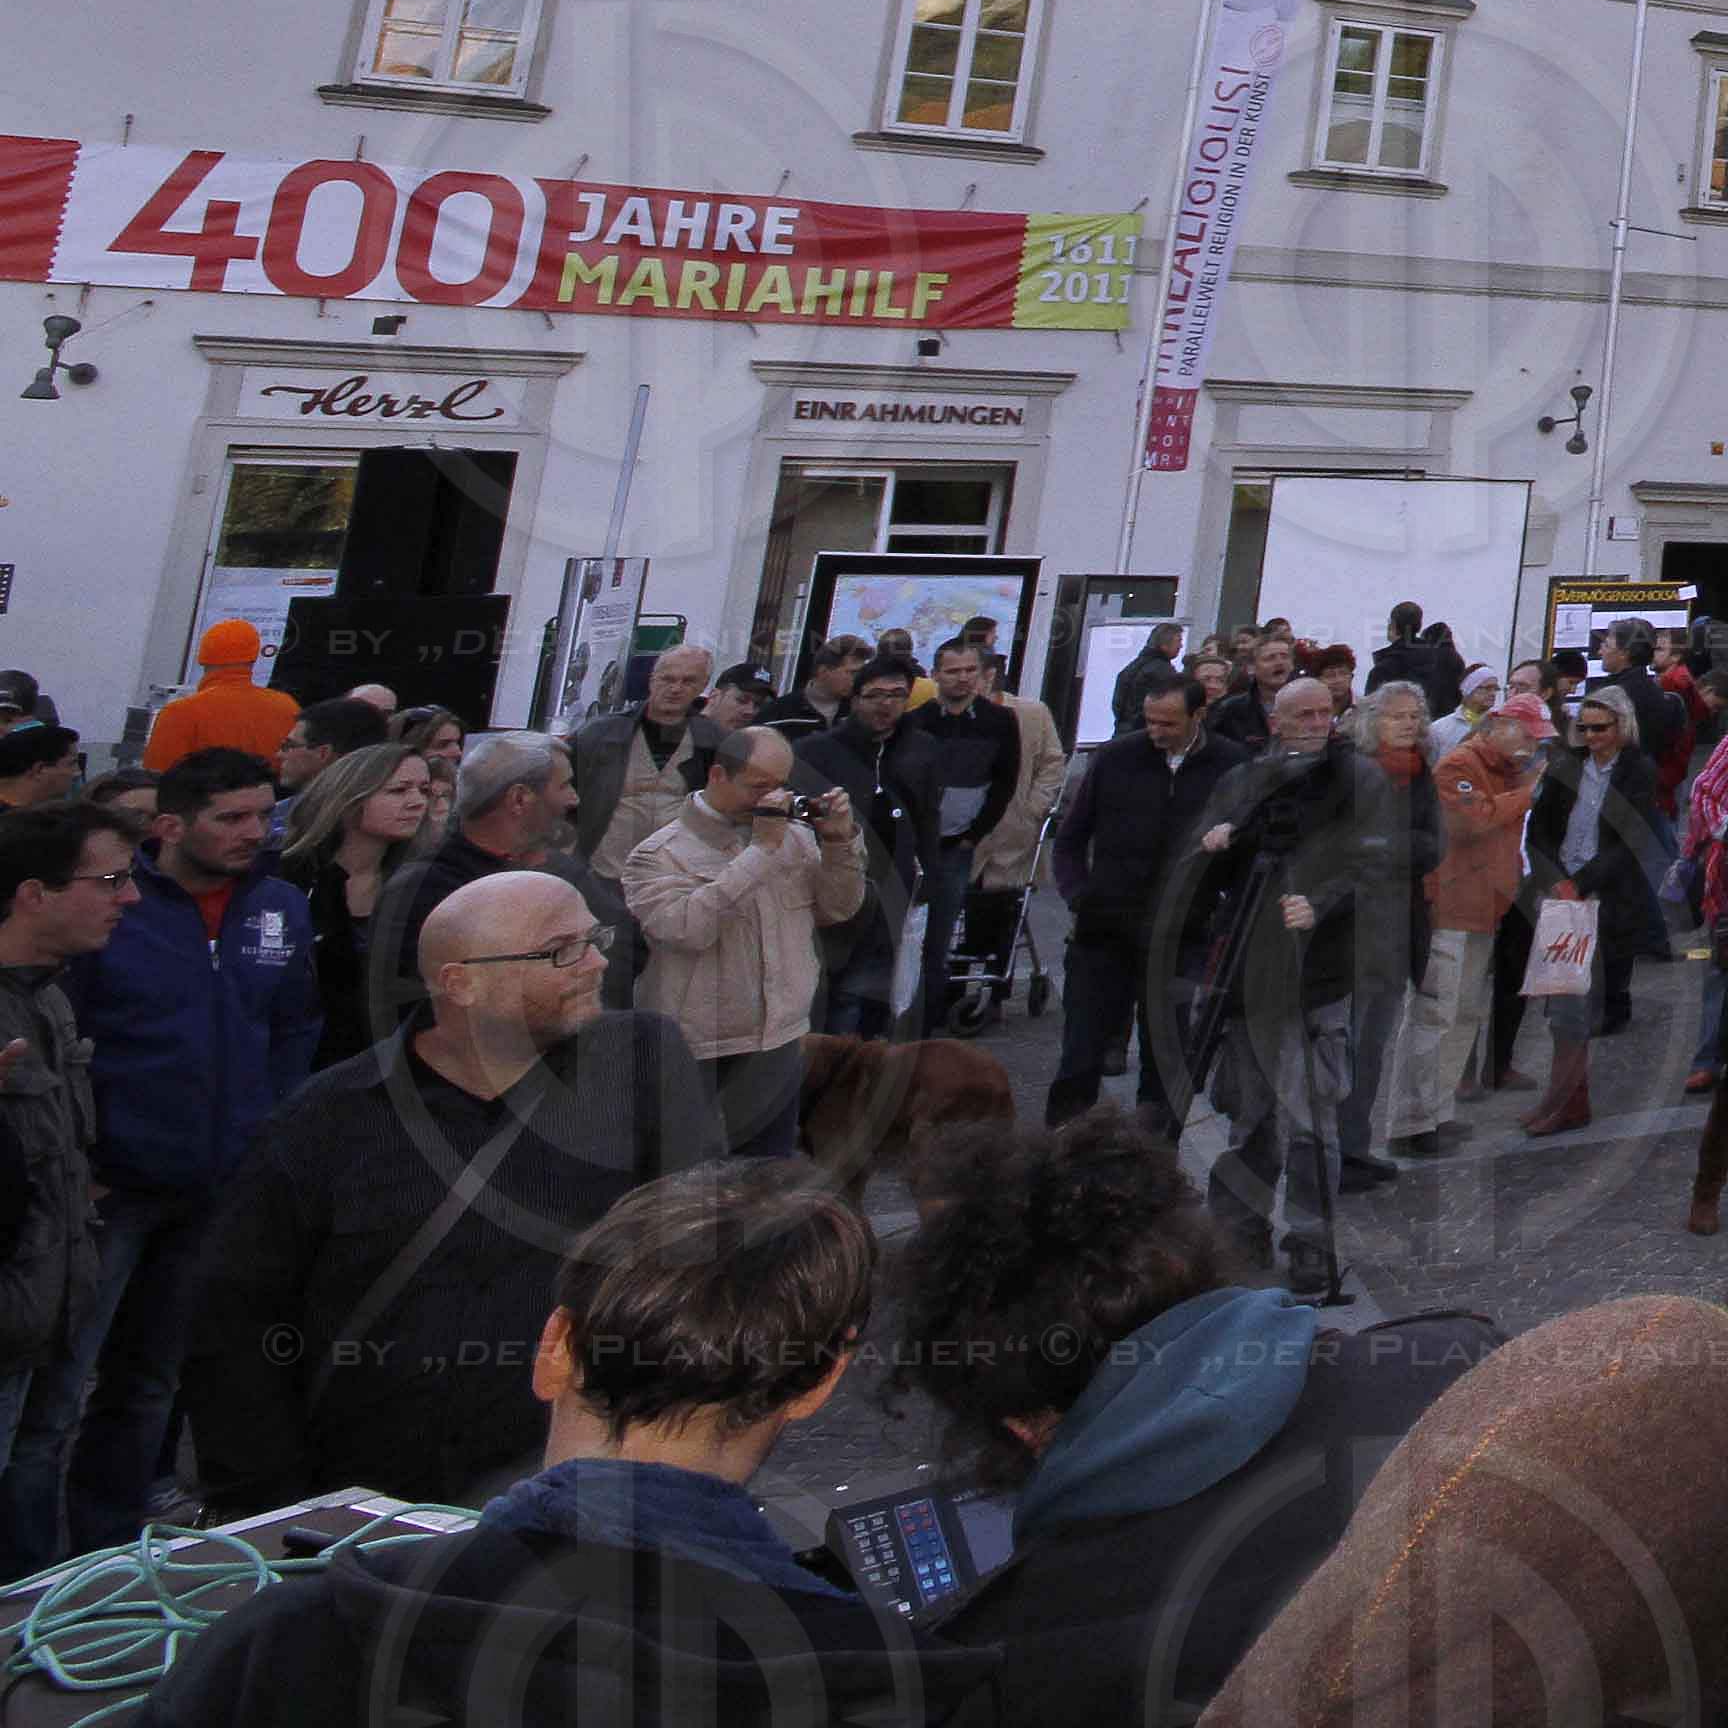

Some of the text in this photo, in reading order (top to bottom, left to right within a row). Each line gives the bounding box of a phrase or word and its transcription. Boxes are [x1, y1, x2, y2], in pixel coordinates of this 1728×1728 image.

[105, 149, 528, 306] 400
[567, 191, 801, 256] JAHRE
[1047, 233, 1137, 265] 1611
[1177, 72, 1272, 377] PARALLELWELT RELIGION IN DER KUNST
[557, 251, 951, 320] MARIAHILF
[1039, 271, 1129, 304] 2011
[260, 374, 506, 422] Herzl
[793, 400, 1024, 428] EINRAHMUNGEN
